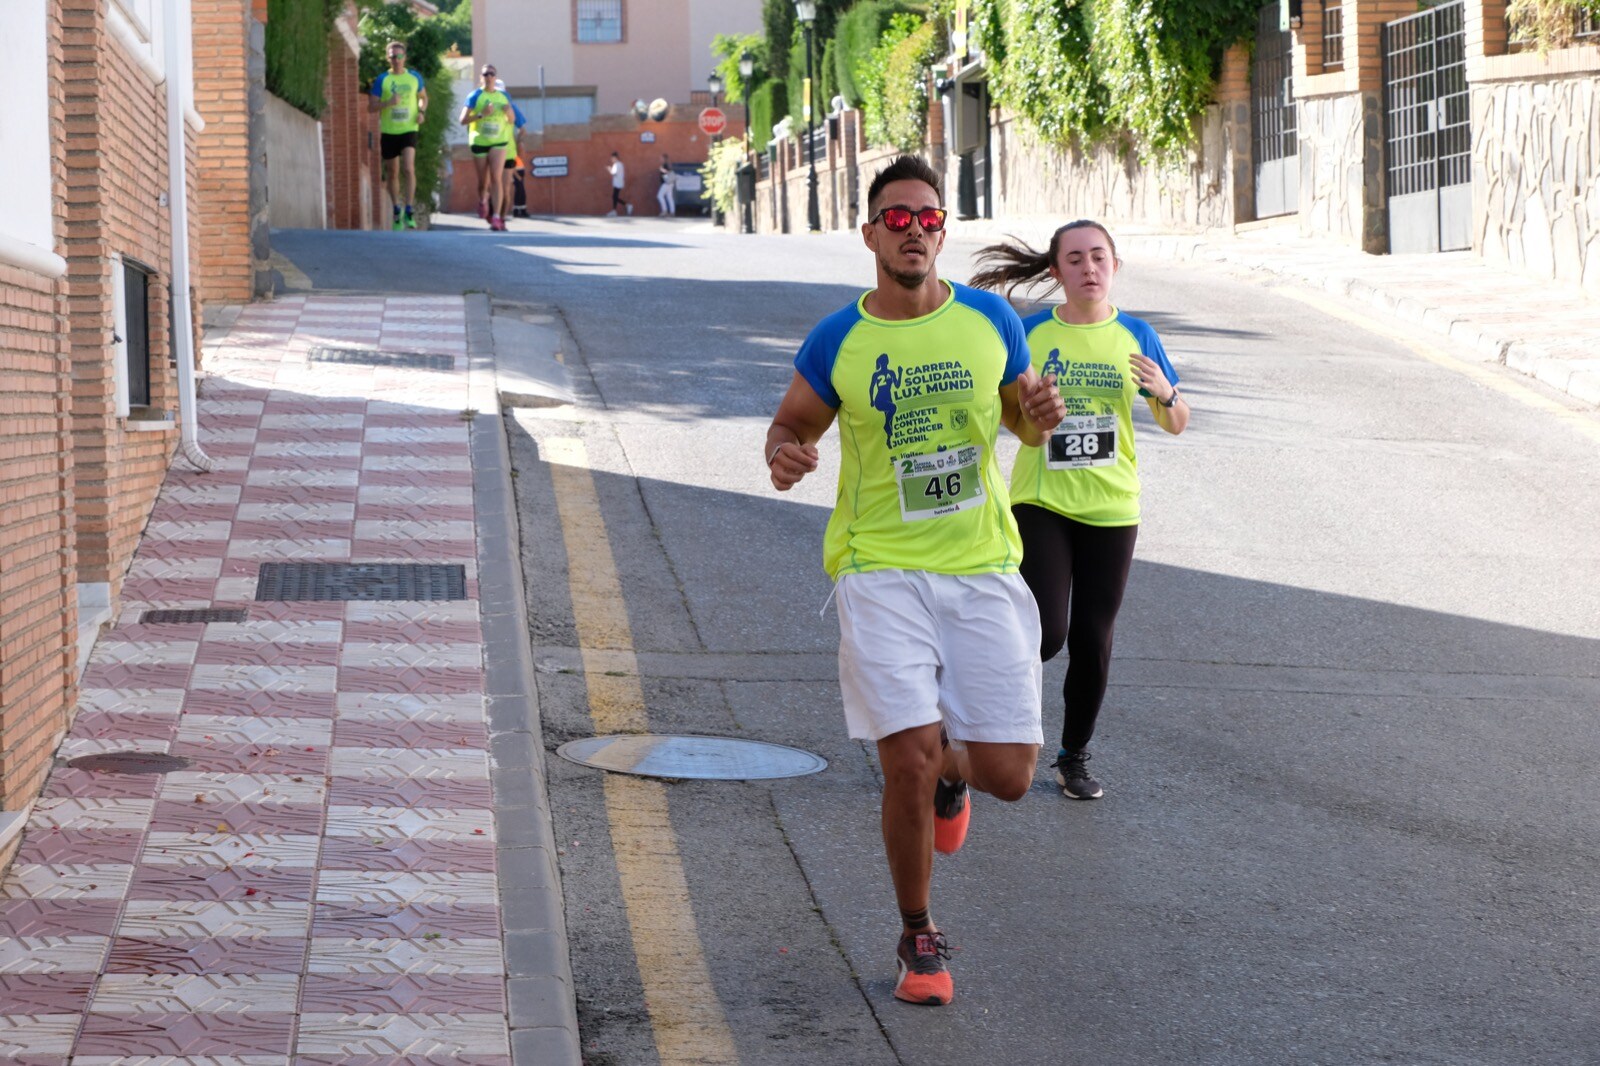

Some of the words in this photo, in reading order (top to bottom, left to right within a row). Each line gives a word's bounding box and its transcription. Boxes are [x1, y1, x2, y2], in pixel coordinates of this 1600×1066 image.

[701, 116, 724, 126] STOP
[905, 361, 962, 376] CARRERA
[1072, 362, 1117, 371] CARRERA
[904, 369, 973, 387] SOLIDARIA
[1070, 370, 1123, 380] SOLIDARIA
[894, 386, 923, 401] LUX
[926, 378, 974, 394] MUNDI
[1060, 379, 1082, 387] LUX
[1085, 380, 1124, 389] MUNDI
[1064, 396, 1092, 404] UÉVETE
[895, 407, 938, 422] MUÉVETE
[893, 417, 931, 430] CONTRA
[894, 430, 906, 438] EL
[906, 423, 943, 436] CÁNCER
[892, 435, 929, 448] JUVENIL
[1065, 433, 1099, 456] 26
[924, 473, 961, 500] 46
